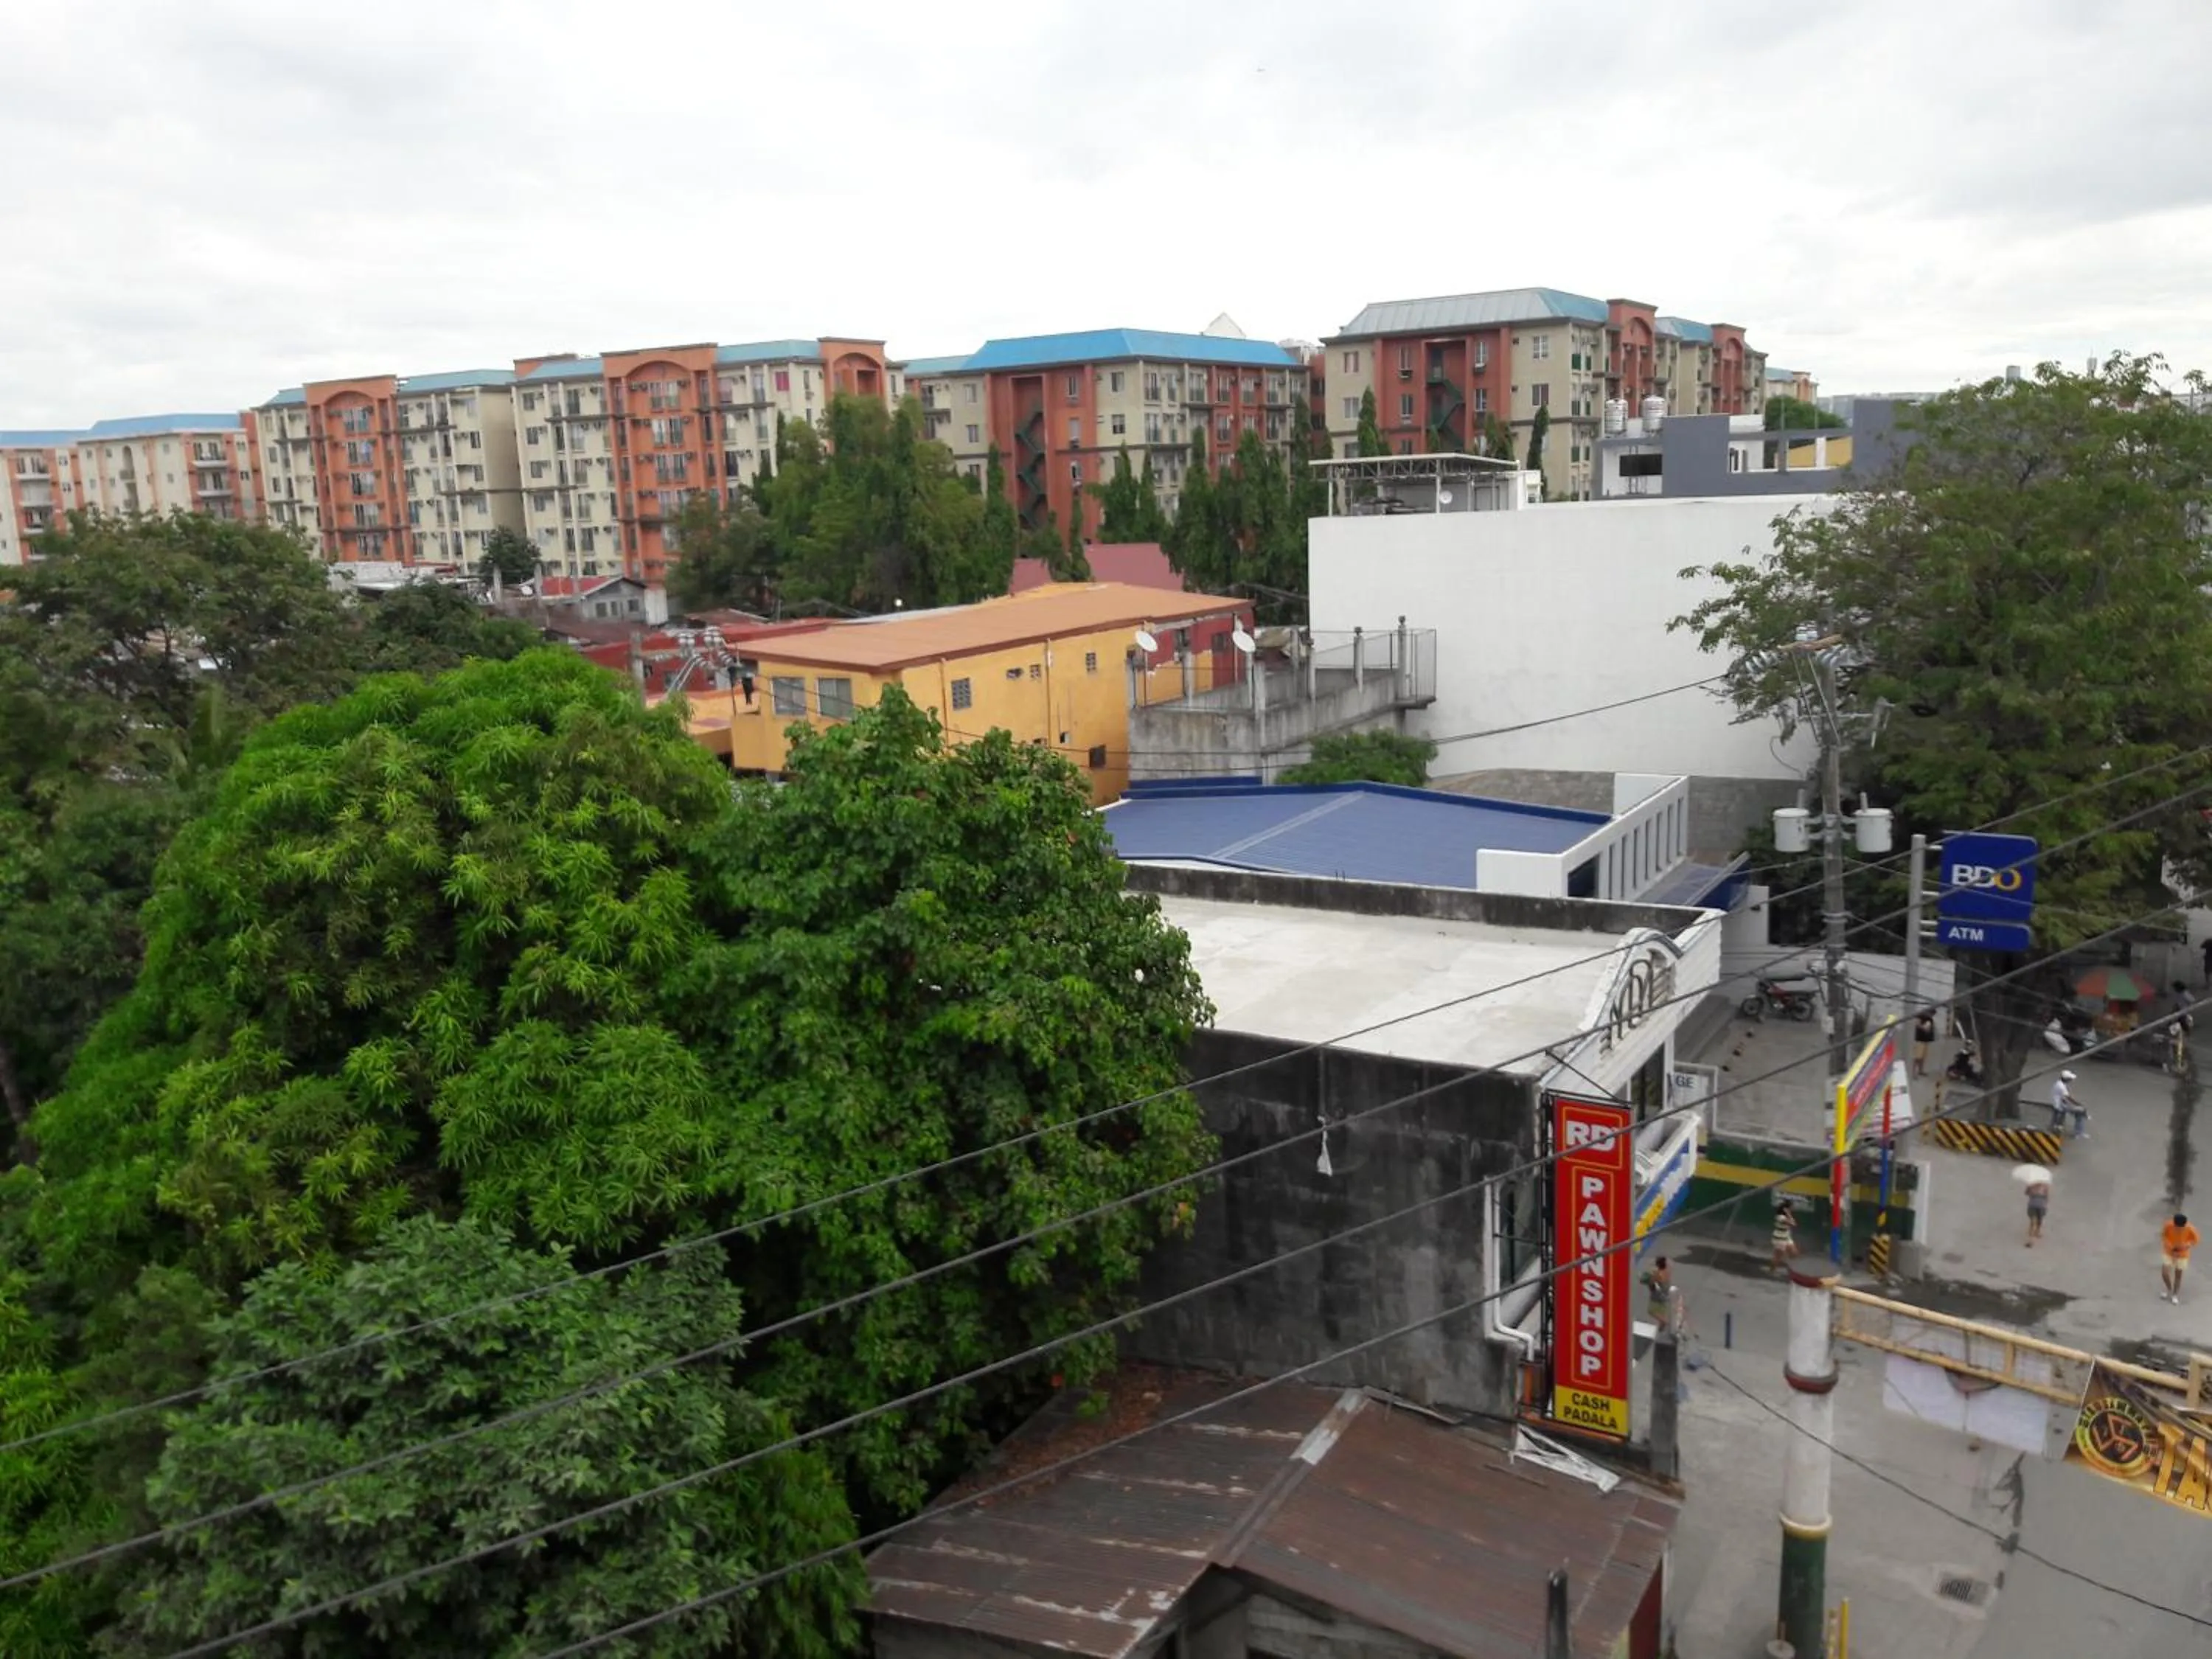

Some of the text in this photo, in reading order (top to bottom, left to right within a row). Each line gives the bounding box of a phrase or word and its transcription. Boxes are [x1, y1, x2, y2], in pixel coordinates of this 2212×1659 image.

[1951, 863, 2022, 891] BDO
[1948, 926, 1984, 942] ATM
[1565, 1120, 1616, 1152] RD
[1578, 1176, 1607, 1377] PAWNSHOP
[1571, 1392, 1610, 1412] CASH
[1564, 1405, 1618, 1429] PADALA
